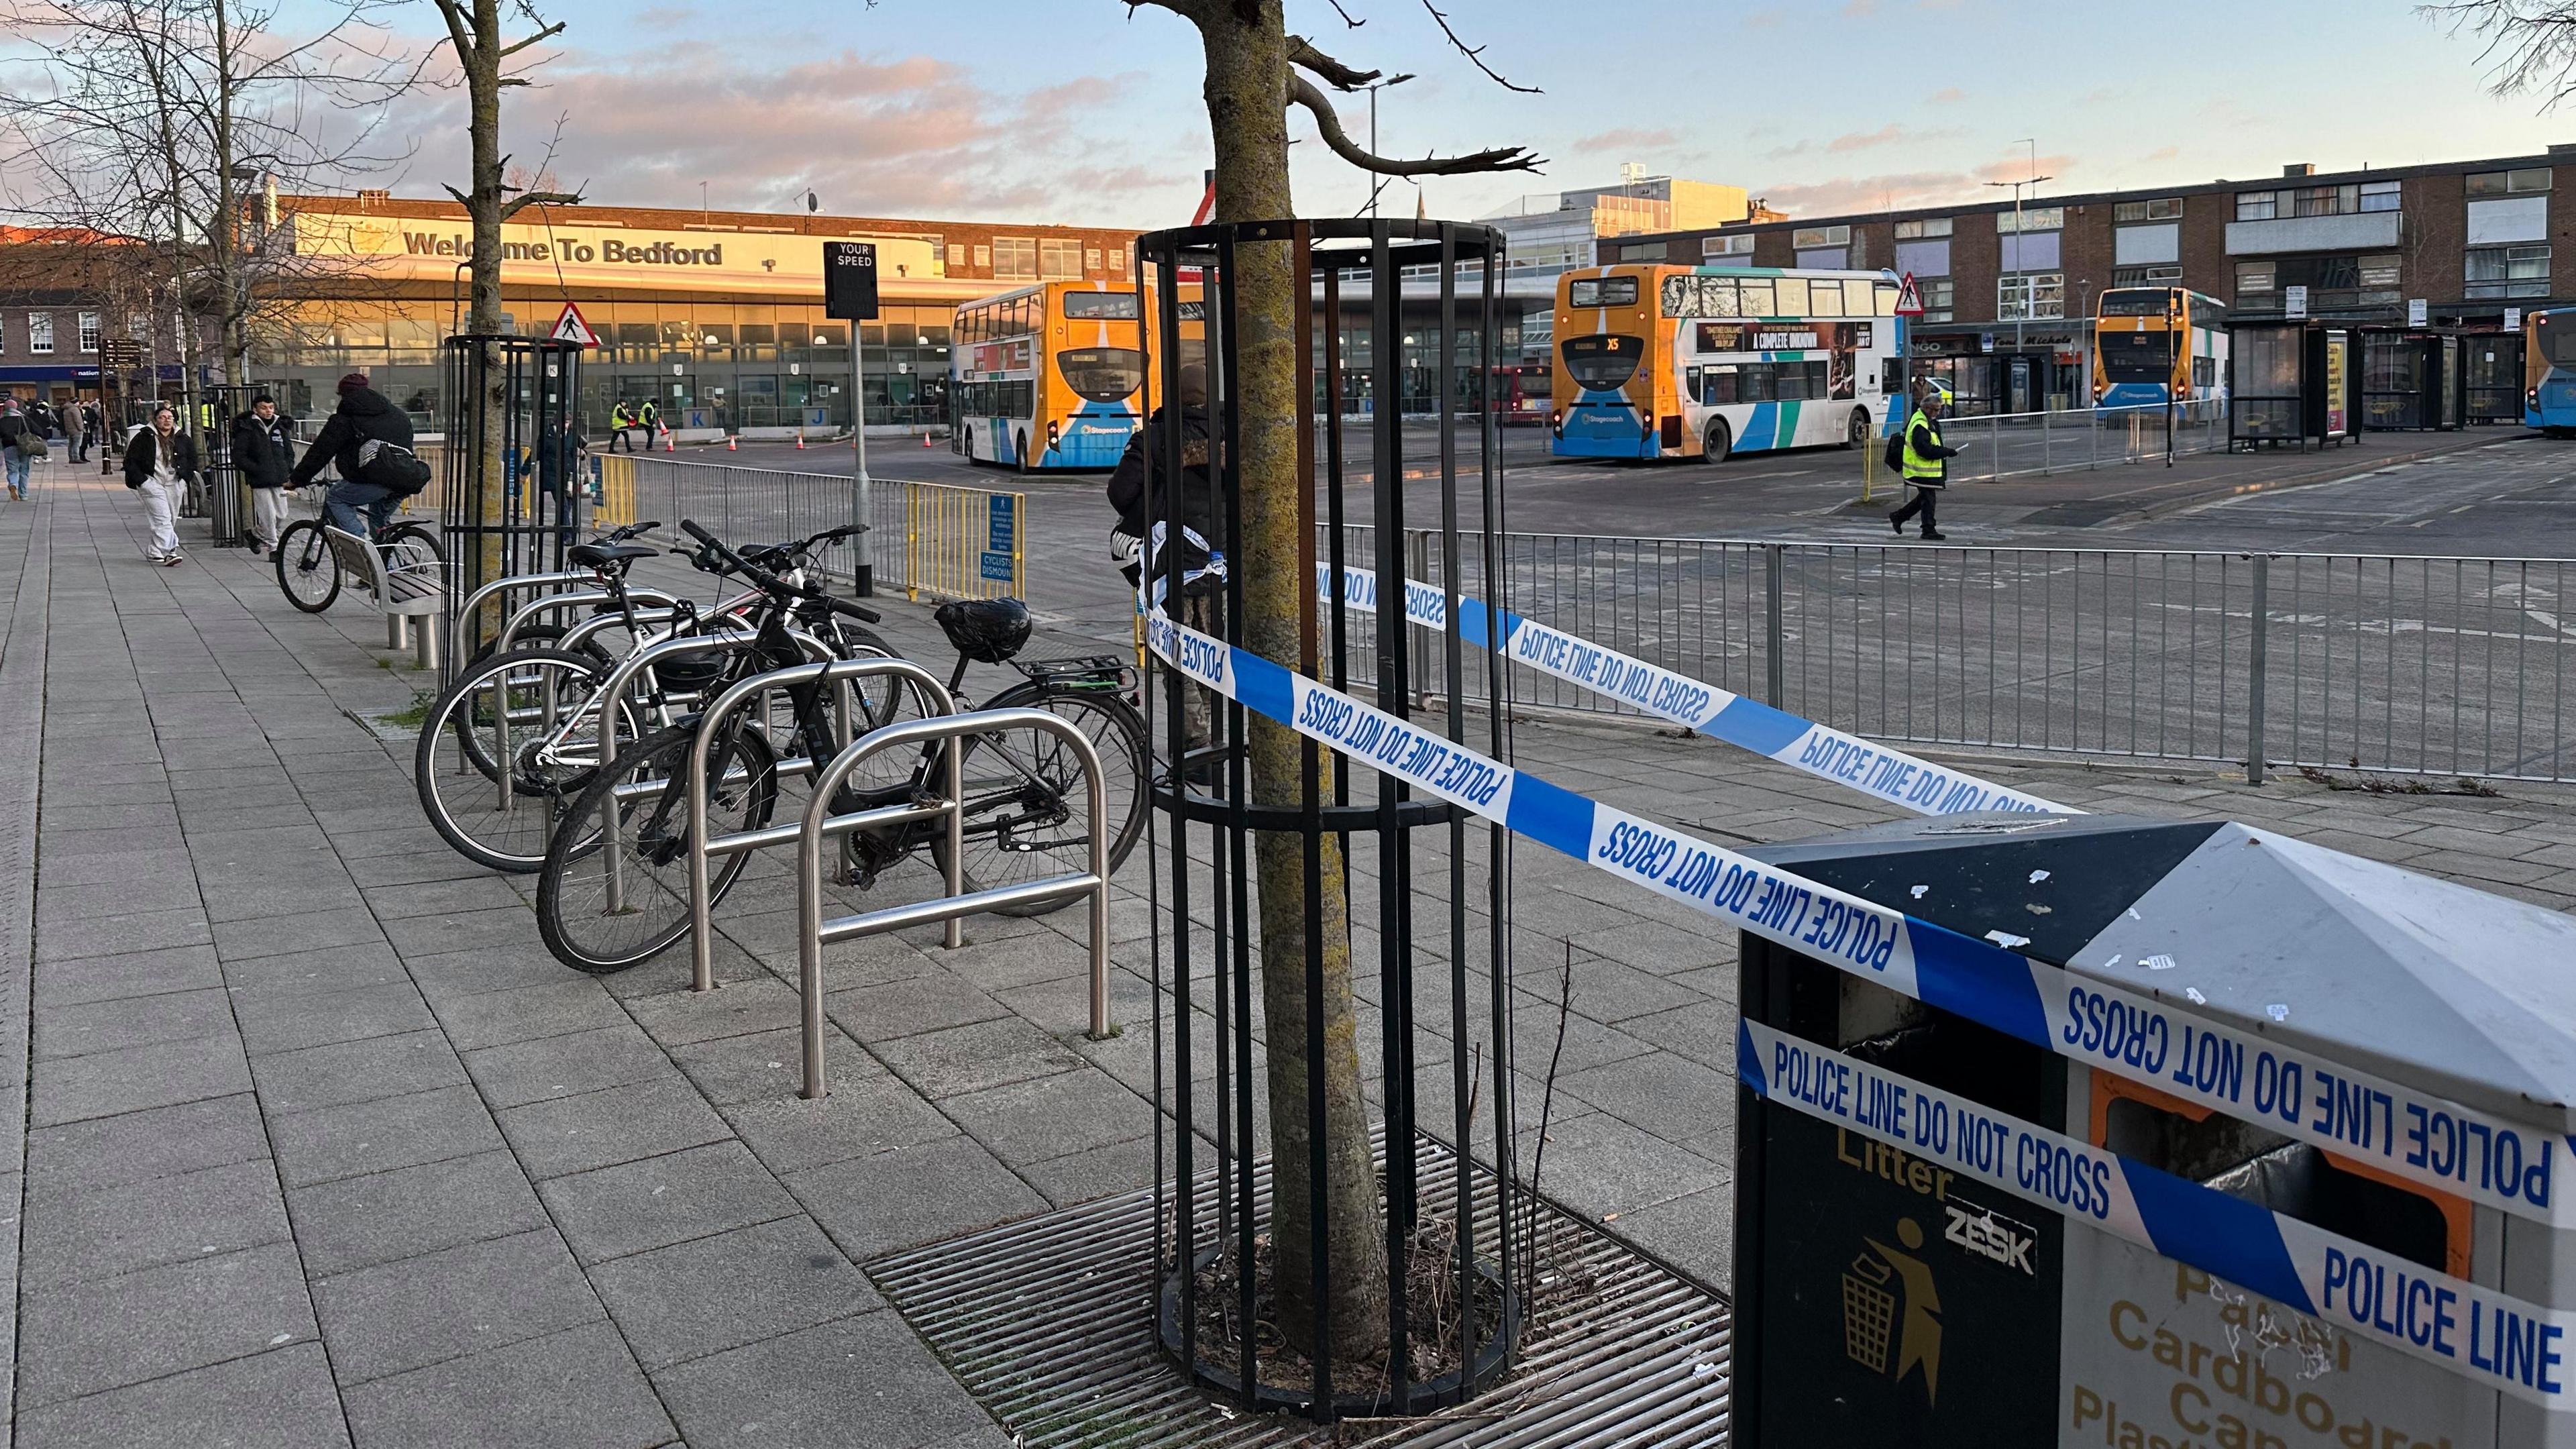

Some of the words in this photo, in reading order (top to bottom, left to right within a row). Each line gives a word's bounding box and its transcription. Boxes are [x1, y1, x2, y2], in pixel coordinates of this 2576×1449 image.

[402, 232, 549, 260] Welcme
[556, 238, 594, 262] To
[602, 239, 722, 265] Bedford
[837, 255, 872, 266] SPEED
[839, 244, 869, 255] YOUR
[1607, 338, 1619, 350] X5
[1753, 333, 1758, 349] A
[1759, 332, 1788, 349] COMPLETE
[1789, 331, 1817, 348] UNKNOWN
[692, 412, 704, 427] K
[812, 409, 822, 425] J
[1091, 425, 1129, 434] Stagecoach
[1589, 416, 1623, 424] Stagecoach
[984, 555, 1013, 567] CYCLISTS
[1182, 633, 1226, 684] POLICE
[1299, 688, 1353, 740] CROSS
[1343, 711, 1387, 755] NOT
[1376, 725, 1411, 765] DO
[1398, 736, 1449, 781] LINE
[1434, 753, 1507, 806] POLICE
[1598, 820, 1677, 880] CROSS
[1664, 847, 1723, 900] NOT
[1713, 863, 1759, 915] DO
[1747, 875, 1812, 937] LINE
[1802, 896, 1898, 972] POLICE
[2062, 986, 2168, 1074] CROSS
[2173, 1026, 2243, 1103] NOT
[2254, 1051, 2302, 1124] DO
[1774, 1041, 1849, 1117] POLICE
[1856, 1072, 1907, 1139] LINE
[1915, 1093, 1949, 1155] DO
[1957, 1109, 2009, 1178] NOT
[2017, 1132, 2110, 1220] CROSS
[2313, 1071, 2393, 1157] LINE
[2407, 1102, 2552, 1209] POLICE
[2324, 1246, 2457, 1358] POLICE
[2469, 1299, 2563, 1394] LINE
